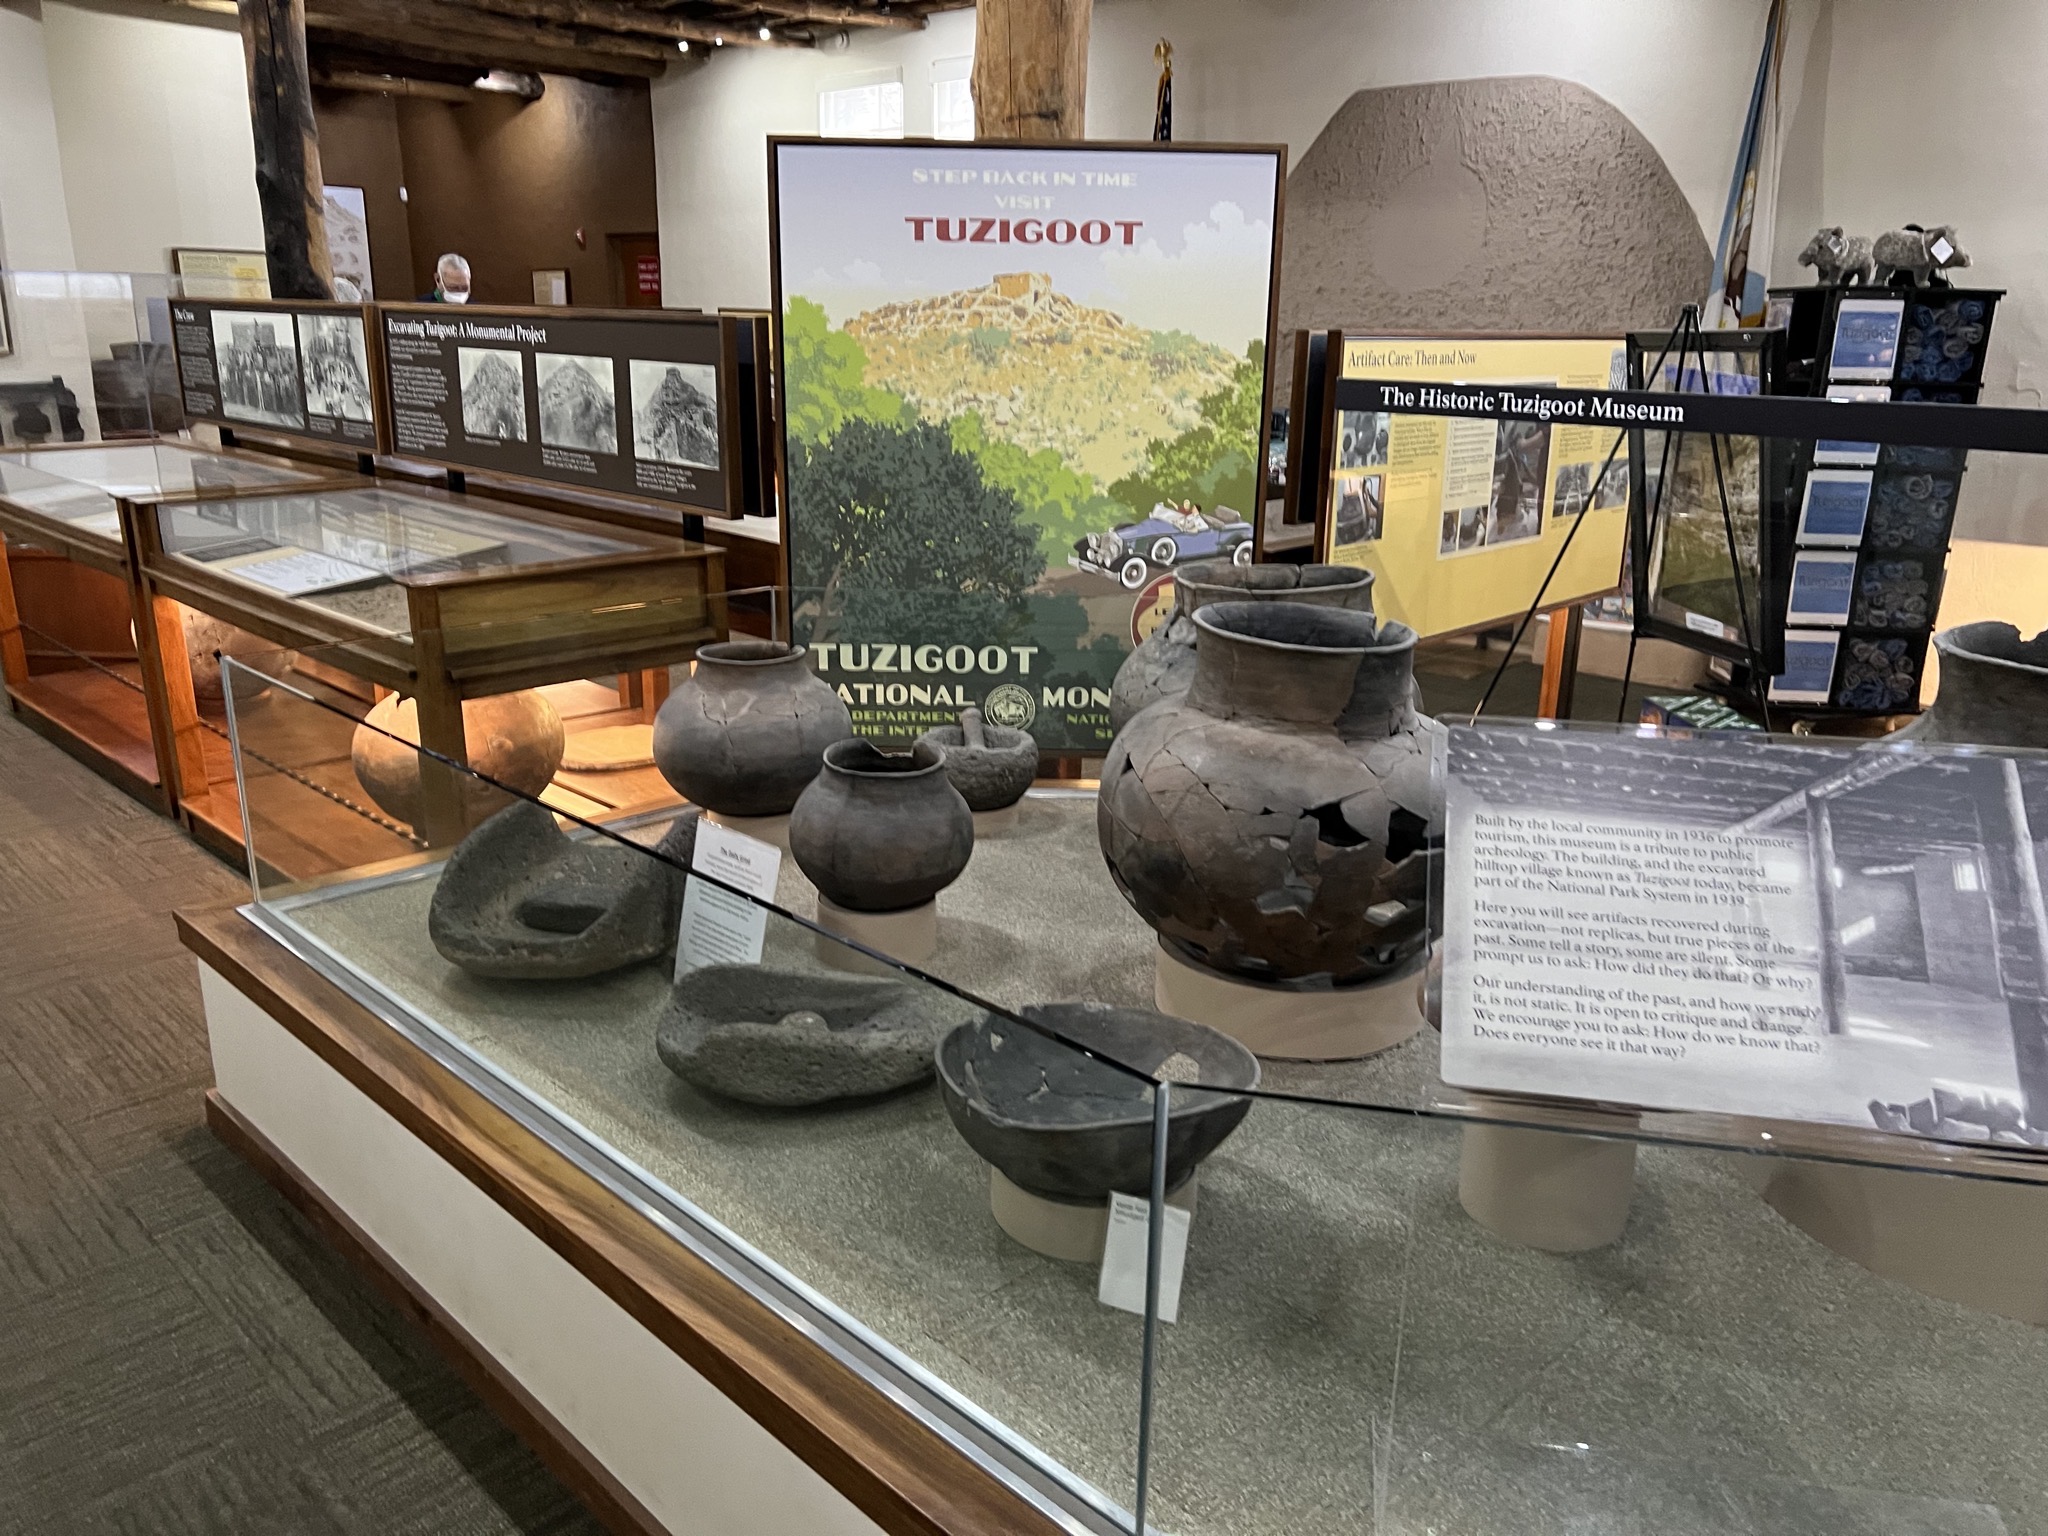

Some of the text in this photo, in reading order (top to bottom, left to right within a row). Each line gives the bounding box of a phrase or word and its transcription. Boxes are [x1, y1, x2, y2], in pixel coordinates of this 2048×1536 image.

[912, 168, 1138, 187] STEP BACK IN TIME
[994, 194, 1054, 210] VISIT
[904, 216, 1144, 246] TUZIGOOT
[387, 317, 547, 347] Excavating Tuzigoot: A Monumental Project
[1349, 349, 1477, 369] Artifact Care: Then and Now
[1380, 386, 1685, 423] The Historic Tuzigoot Museum
[809, 642, 1038, 675] TUZIGOOT
[828, 683, 976, 707] ATIONAL
[852, 724, 884, 736] THE
[1475, 814, 1795, 850] Built by the local community in 1936 to promote
[1475, 830, 1754, 861] tourism, this museum is a tribute to public
[1474, 845, 1767, 878] archeology. The building, and the excavated
[1474, 857, 1793, 896] hilltop village known as Tuzigoot today, became
[1474, 875, 1501, 889] part
[1504, 876, 1520, 888] of
[1522, 878, 1544, 891] the
[1548, 880, 1606, 896] National
[1610, 885, 1640, 898] Park
[1643, 887, 1692, 904] System
[1694, 892, 1708, 904] in
[1474, 899, 1771, 939] Here you will see artifacts recovered during
[1473, 933, 1776, 970] past. Some tell a story, some are silent. Some
[1588, 927, 1644, 942] replicas,
[1647, 930, 1671, 945] but
[1674, 934, 1703, 946] true
[1707, 938, 1750, 951] pieces
[1753, 941, 1769, 952] of
[1772, 942, 1795, 955] the
[1473, 950, 1814, 992] prompt us to ask: How did they do that? Or why?
[1473, 974, 1502, 989] Our
[1504, 979, 1606, 1002] understanding
[1608, 987, 1625, 1001] of
[1627, 989, 1650, 1004] the
[1653, 994, 1686, 1008] past,
[1689, 997, 1717, 1010] and
[1720, 997, 1752, 1013] how
[1754, 1004, 1776, 1015] we
[1473, 991, 1486, 1005] it,
[1490, 993, 1501, 1005] is
[1503, 996, 1527, 1008] not
[1531, 998, 1572, 1013] static.
[1575, 1000, 1586, 1014] It
[1589, 1002, 1601, 1015] is
[1603, 1007, 1640, 1020] open
[1643, 1009, 1658, 1021] to
[1661, 1011, 1718, 1028] critique
[1720, 1017, 1749, 1030] and
[1472, 1007, 1821, 1055] We encourage you to ask: How do we know that?
[1473, 1024, 1687, 1062] Does everyone see it that way?
